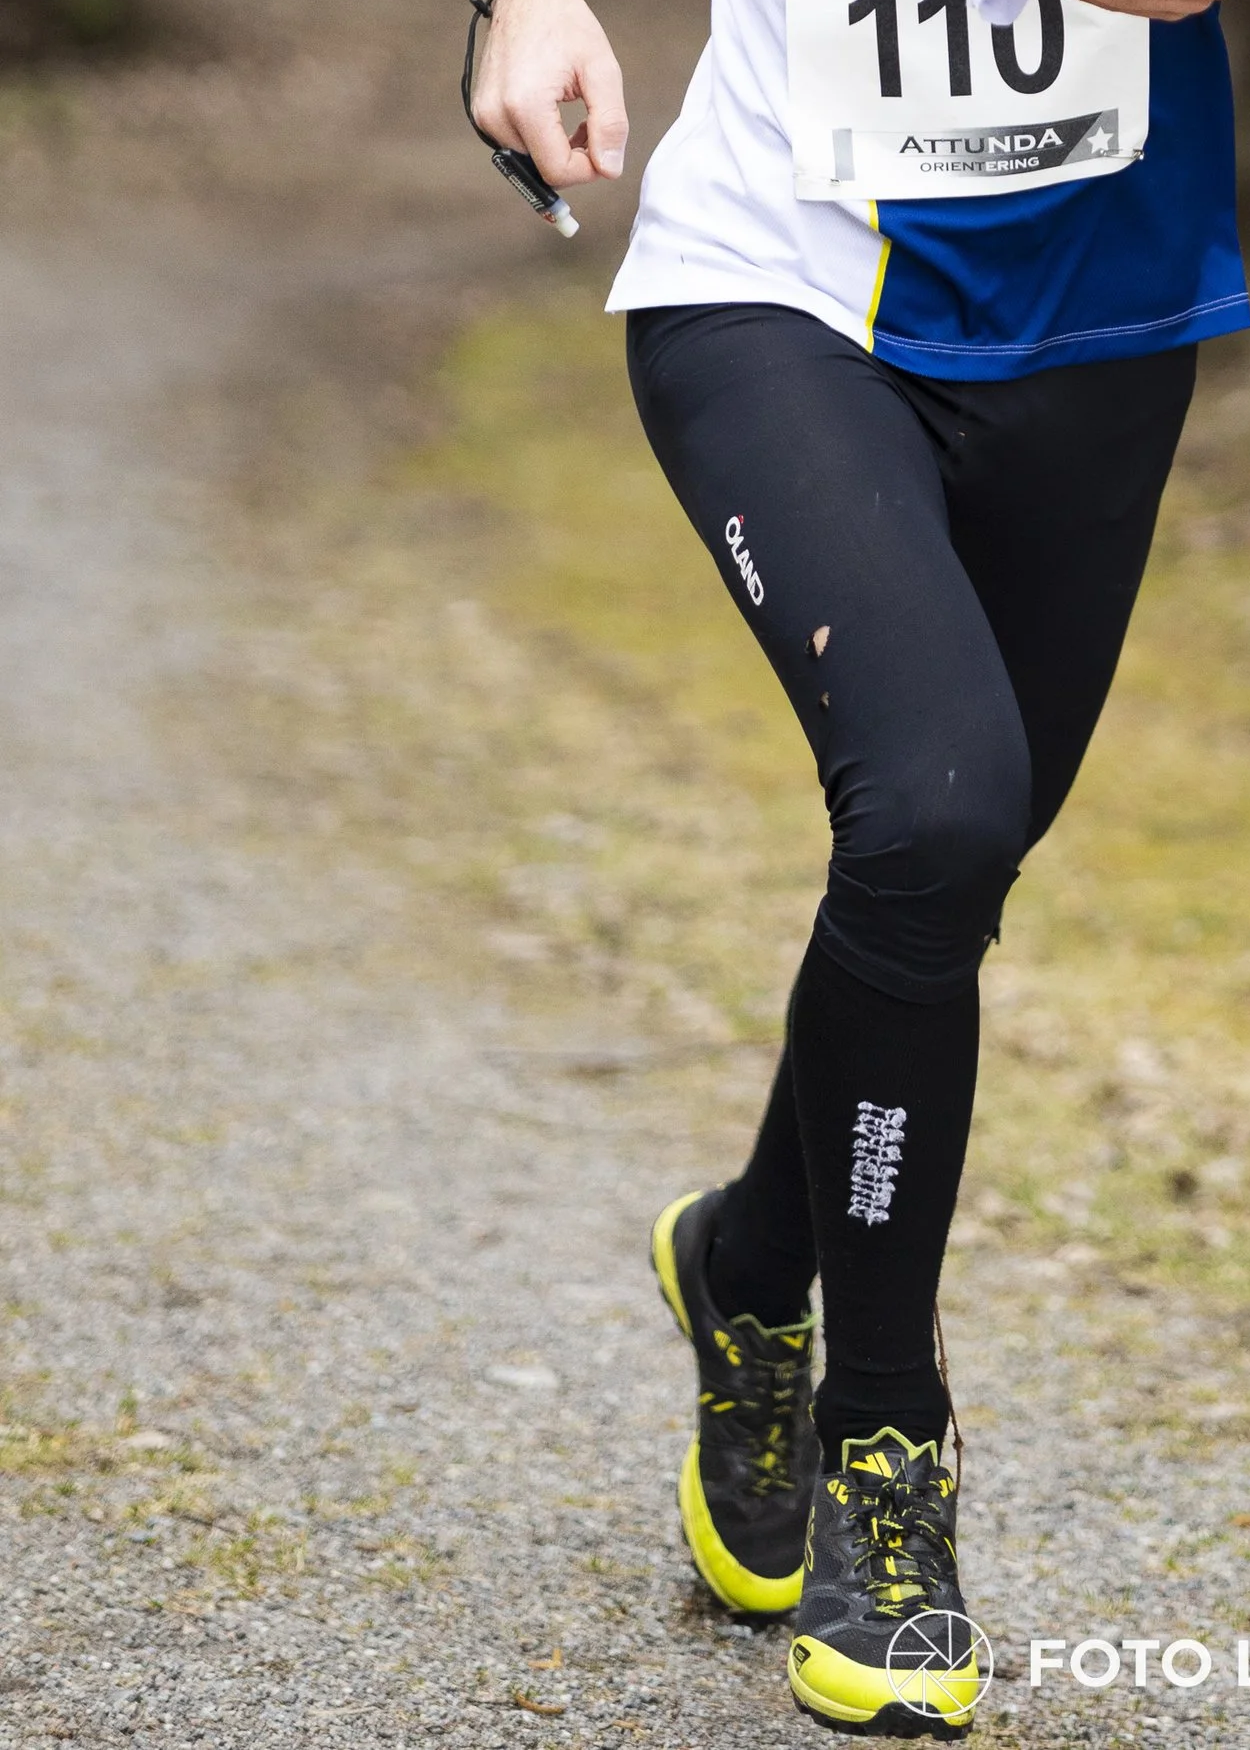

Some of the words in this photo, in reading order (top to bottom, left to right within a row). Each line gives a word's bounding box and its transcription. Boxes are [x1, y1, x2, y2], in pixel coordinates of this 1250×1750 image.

[898, 127, 1065, 155] ATTUNDA
[919, 155, 1040, 173] ORIENTERING
[725, 514, 765, 606] ÖLAND
